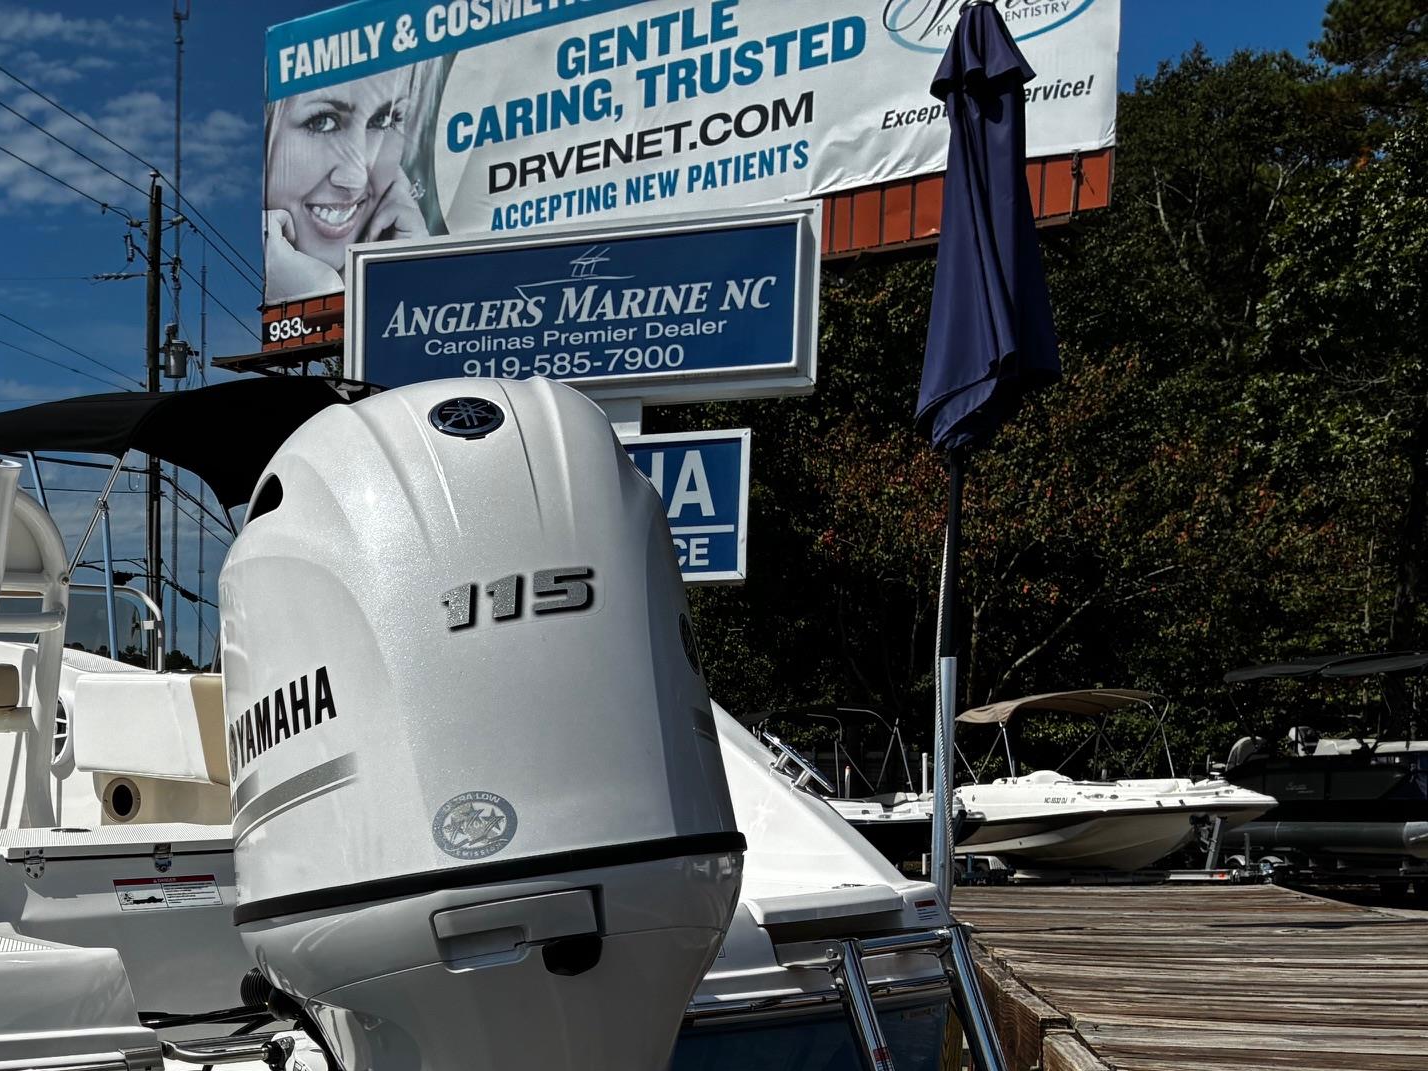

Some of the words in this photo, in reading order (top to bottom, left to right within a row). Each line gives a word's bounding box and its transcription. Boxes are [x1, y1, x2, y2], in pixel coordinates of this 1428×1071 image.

[556, 0, 740, 81] GENTLE
[1004, 1, 1070, 22] ENTISTRY
[279, 20, 386, 84] FAMILY
[392, 14, 419, 52] &
[446, 78, 624, 154] CARING,
[636, 15, 867, 109] TRUSTED
[881, 103, 948, 130] Except
[1024, 75, 1095, 104] ervice!
[488, 91, 814, 194] DRVENET.COM
[490, 181, 618, 232] ACCEPTING
[625, 168, 679, 209] NEW
[687, 140, 810, 194] PATIENTS
[554, 282, 713, 327] MARINE
[719, 275, 777, 312] NC
[424, 334, 535, 357] Carolinas
[543, 325, 640, 348] Premier
[646, 317, 728, 339] Dealer
[462, 344, 685, 380] 919-585-7900
[440, 565, 598, 634] 115
[236, 665, 338, 769] YAMAHA
